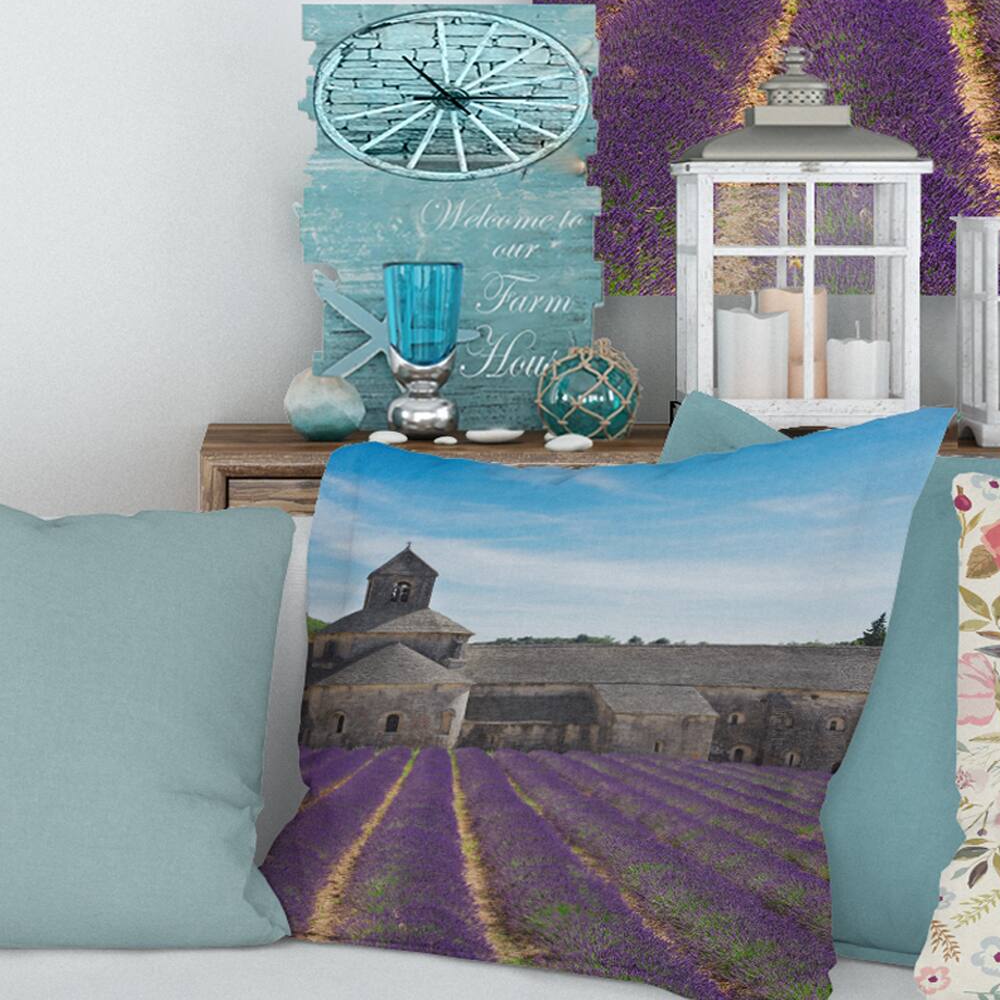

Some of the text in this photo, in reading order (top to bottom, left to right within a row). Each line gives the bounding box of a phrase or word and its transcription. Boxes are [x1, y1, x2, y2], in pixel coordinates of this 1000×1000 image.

[420, 198, 585, 231] Welcome to
[491, 242, 541, 260] our
[475, 270, 574, 315] Farm
[460, 324, 558, 379] Hou
